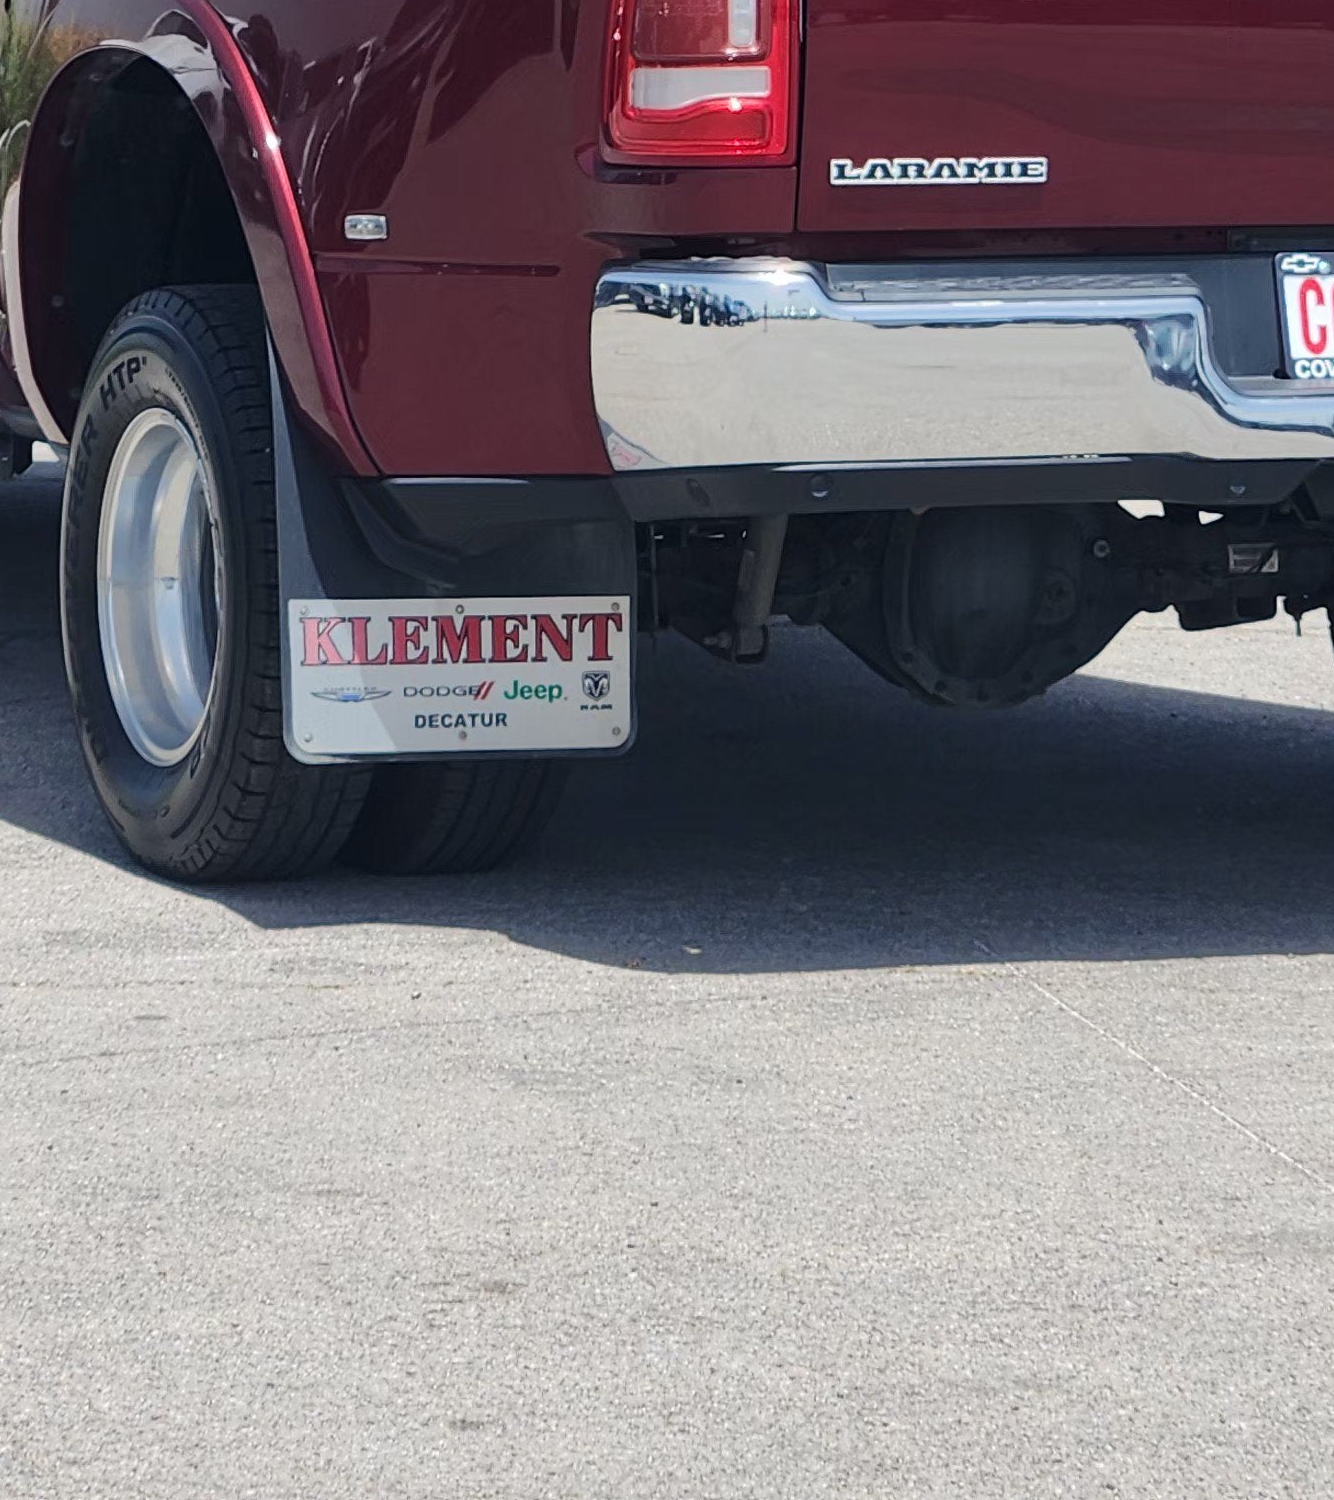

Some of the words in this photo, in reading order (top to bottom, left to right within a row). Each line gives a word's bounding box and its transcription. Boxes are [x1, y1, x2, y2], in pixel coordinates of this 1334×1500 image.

[831, 158, 1047, 184] LARAMIE
[298, 612, 623, 667] KLEMENT
[403, 685, 481, 698] DODGE
[503, 679, 564, 704] Jeep
[414, 712, 508, 729] DECATUR
